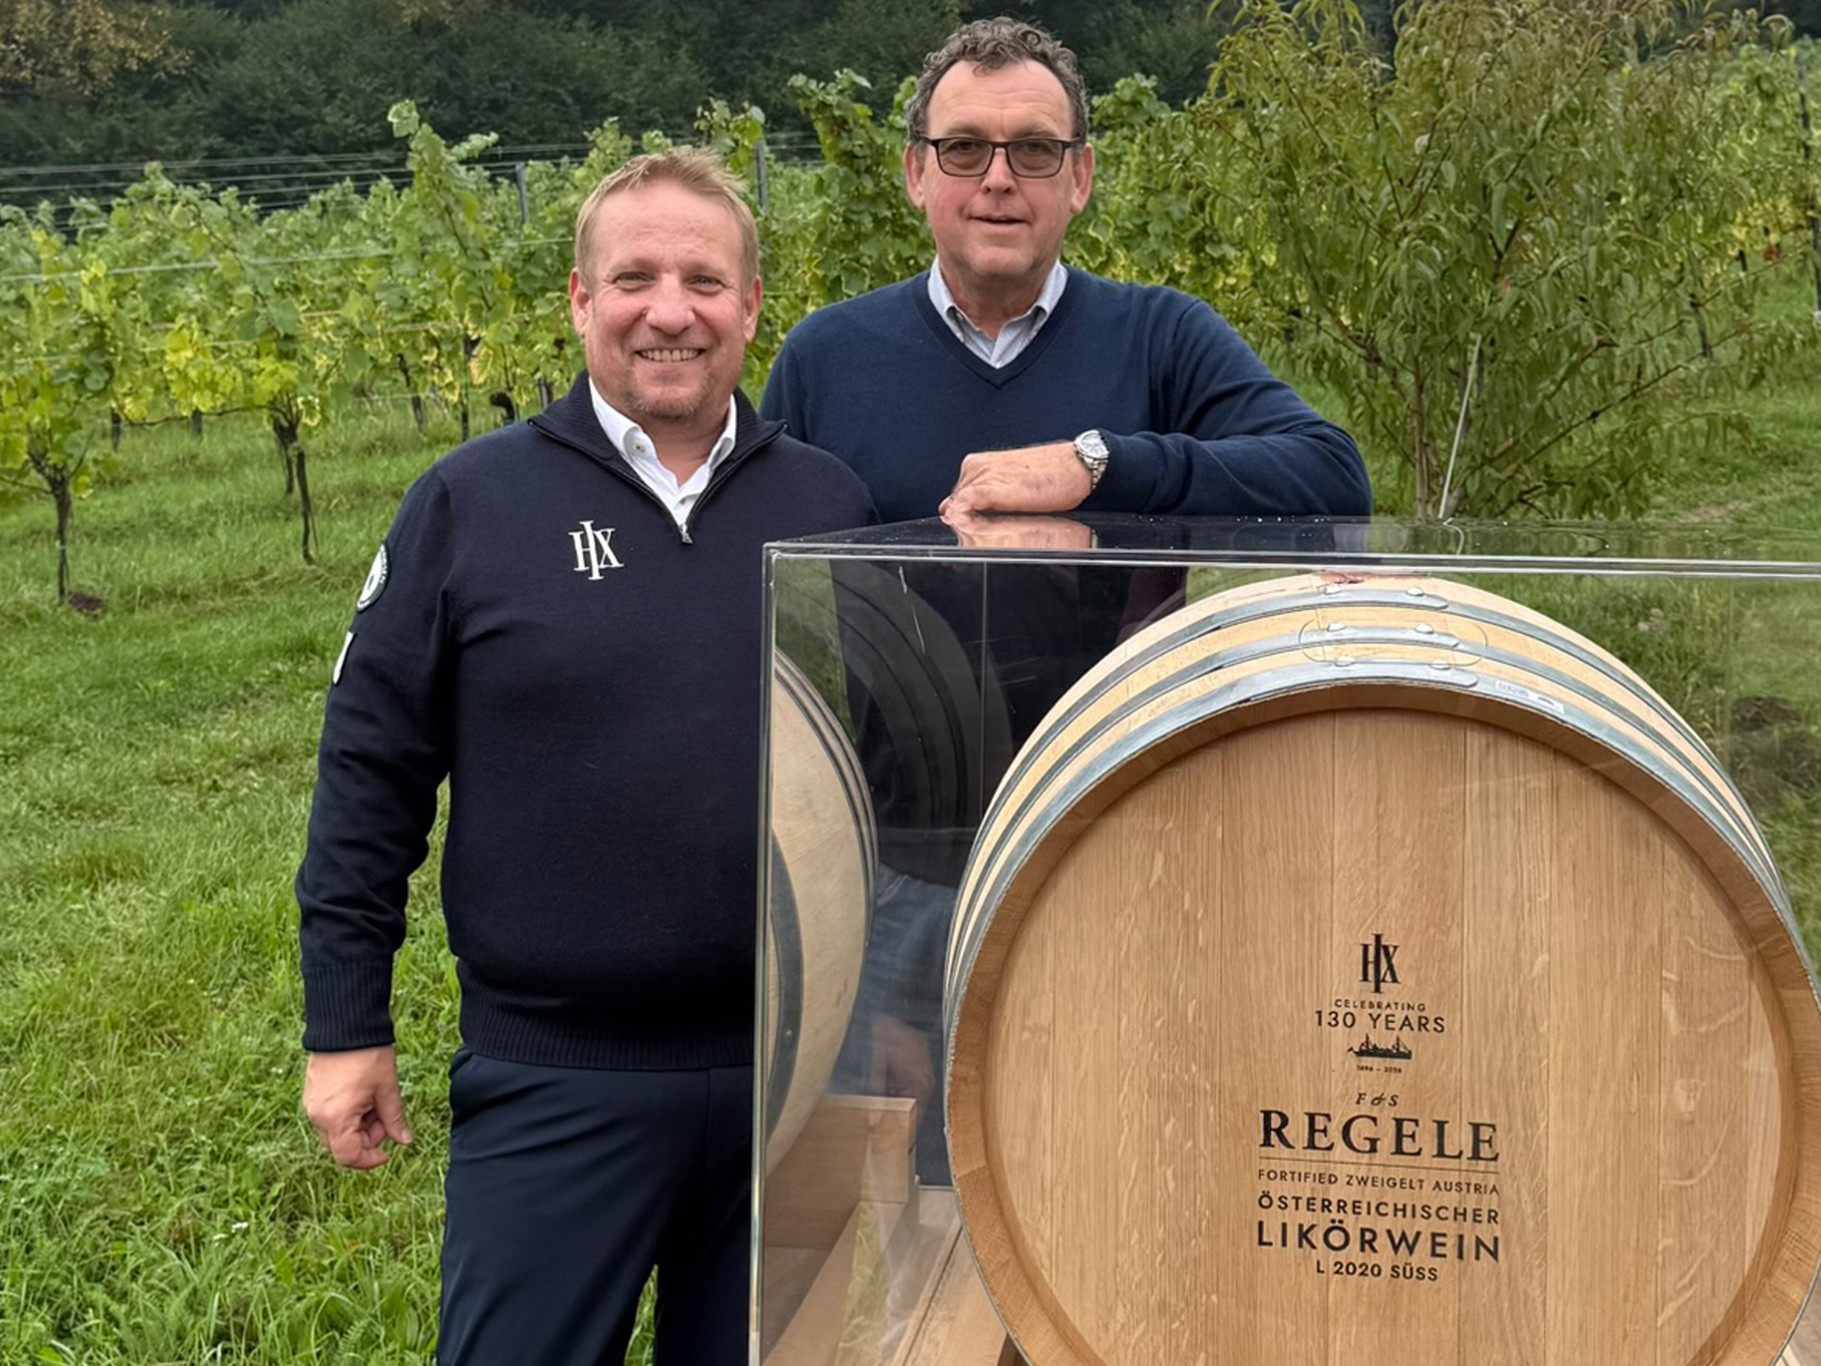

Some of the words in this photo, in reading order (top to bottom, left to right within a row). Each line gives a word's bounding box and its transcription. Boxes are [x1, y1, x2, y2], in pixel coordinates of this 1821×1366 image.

[1334, 999, 1426, 1012] CELEBRATING
[1315, 1010, 1356, 1028] 130
[1369, 1013, 1445, 1033] YEARS
[1355, 1092, 1367, 1104] F
[1388, 1094, 1399, 1107] S
[1258, 1109, 1500, 1162] REGELE
[1258, 1169, 1338, 1185] FORTIFIED
[1346, 1174, 1425, 1190] ZWEIGELT
[1432, 1180, 1499, 1195] AUSTRIA
[1258, 1190, 1499, 1224] ÖSTERREICHISCHER
[1257, 1218, 1499, 1262] LIKÖRWEIN
[1316, 1260, 1325, 1273] L
[1333, 1261, 1382, 1277] 2020
[1390, 1263, 1438, 1281] SÜSS
